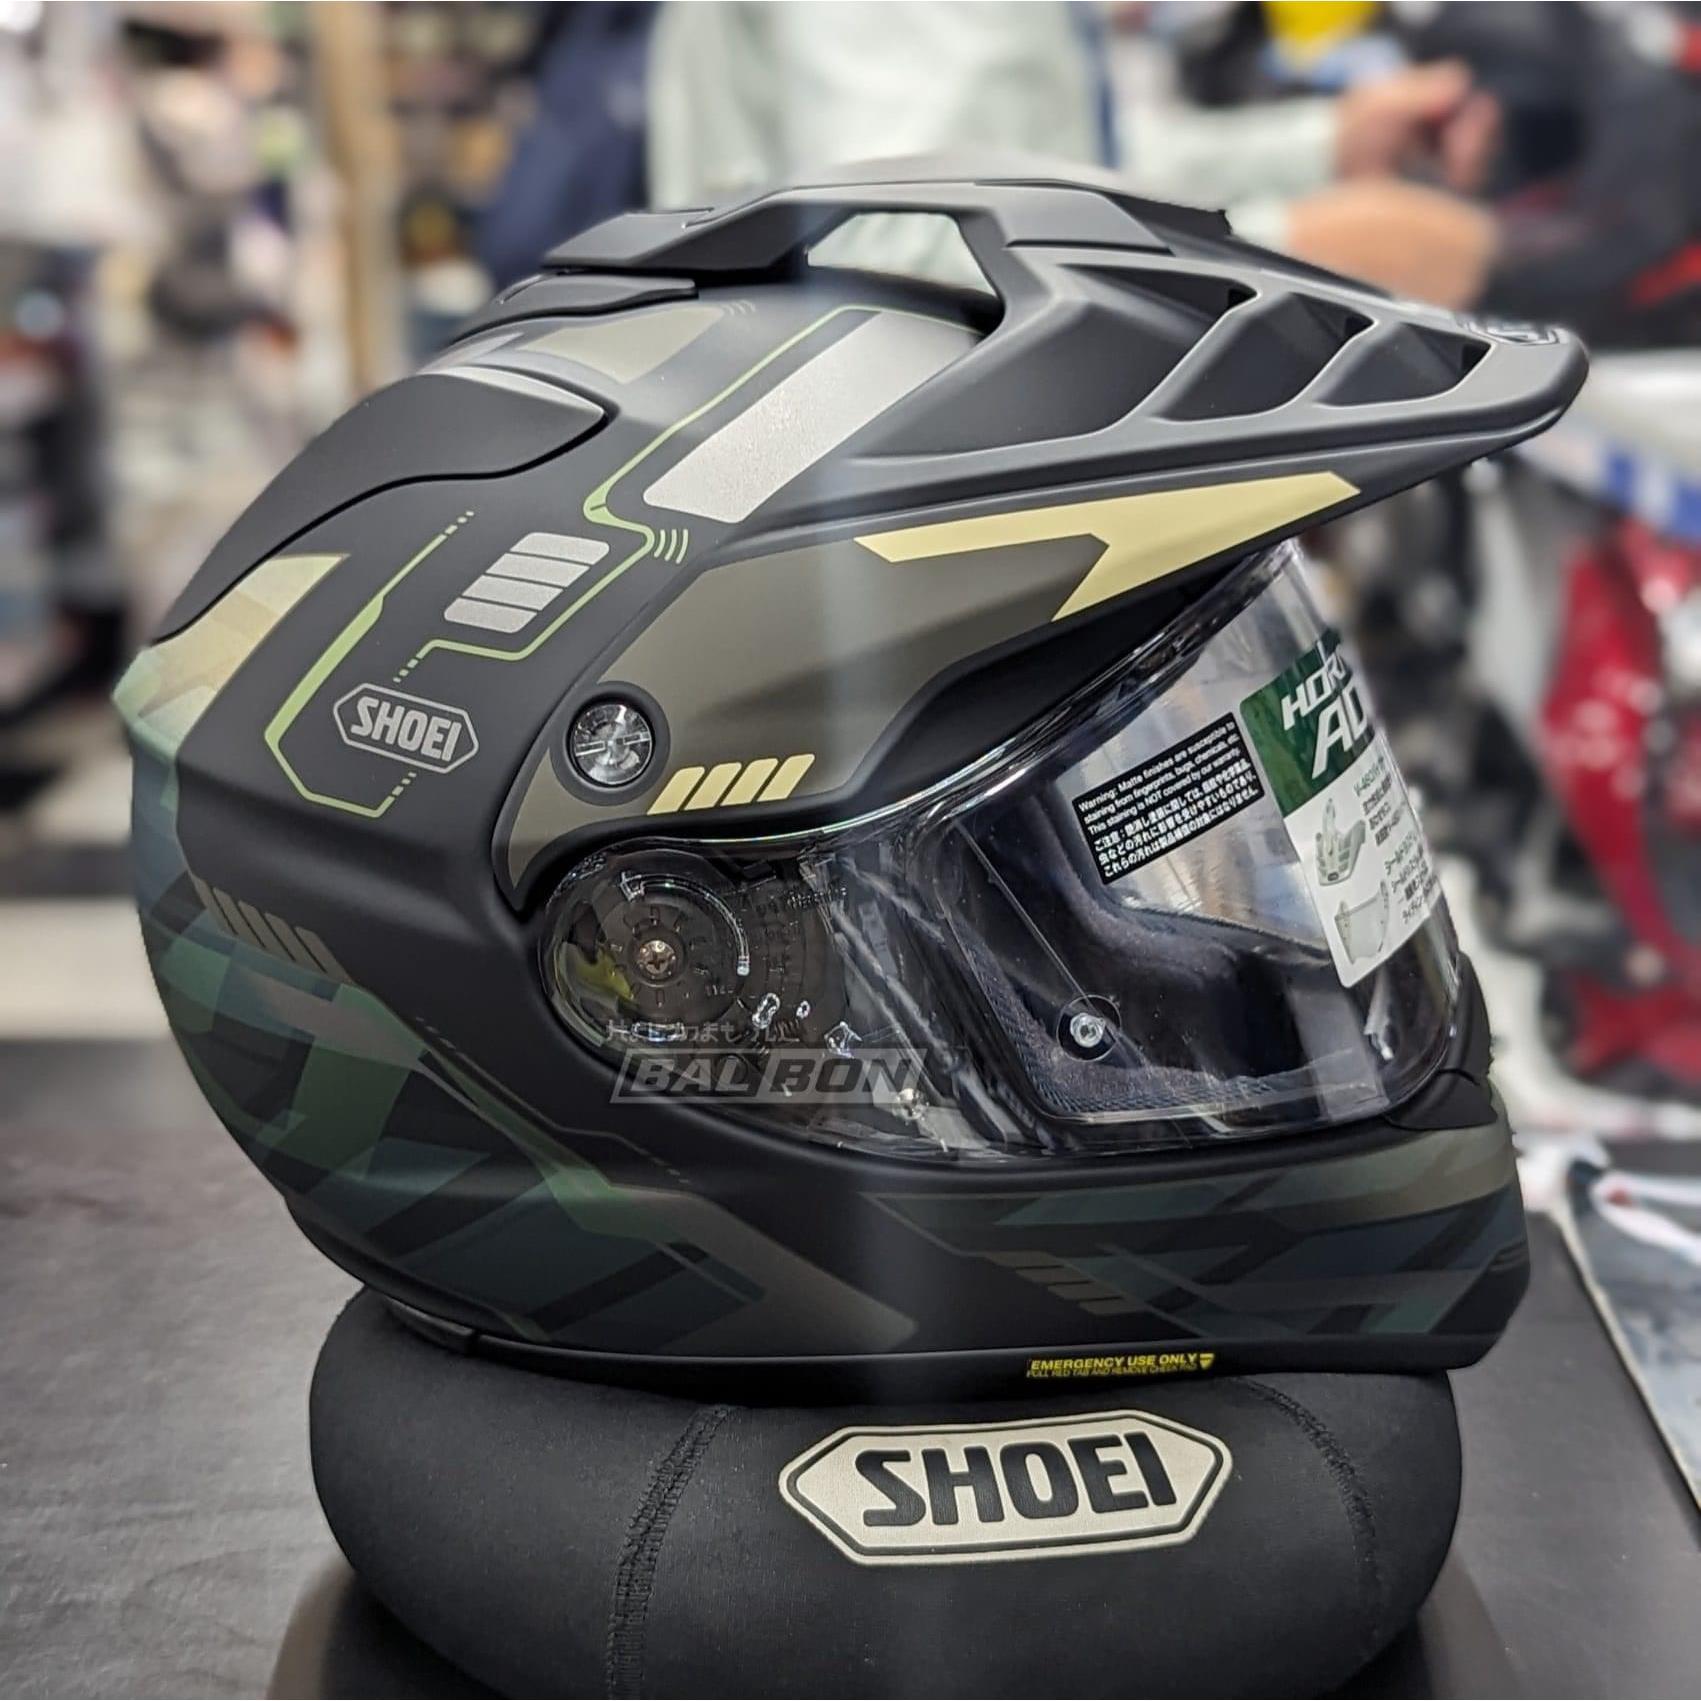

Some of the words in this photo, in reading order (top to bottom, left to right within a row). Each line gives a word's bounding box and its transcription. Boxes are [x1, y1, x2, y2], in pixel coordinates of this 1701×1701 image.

[350, 696, 462, 762] SHOEI
[1078, 788, 1117, 811] Warning:
[1118, 775, 1142, 791] Matte
[1143, 758, 1173, 778] finishes
[1174, 750, 1186, 761] are
[1084, 803, 1115, 823] staining
[1114, 794, 1133, 807] from
[1087, 822, 1106, 834] This
[1106, 806, 1137, 826] staining
[1144, 790, 1161, 805] NOT
[1162, 774, 1191, 795] covered
[1190, 770, 1200, 780] by
[1200, 763, 1212, 774] our
[1030, 1356, 1125, 1370] EMERGENCY
[1127, 1354, 1157, 1366] USE
[1159, 1353, 1198, 1364] ONLY
[855, 1432, 1178, 1527] SHOEI
